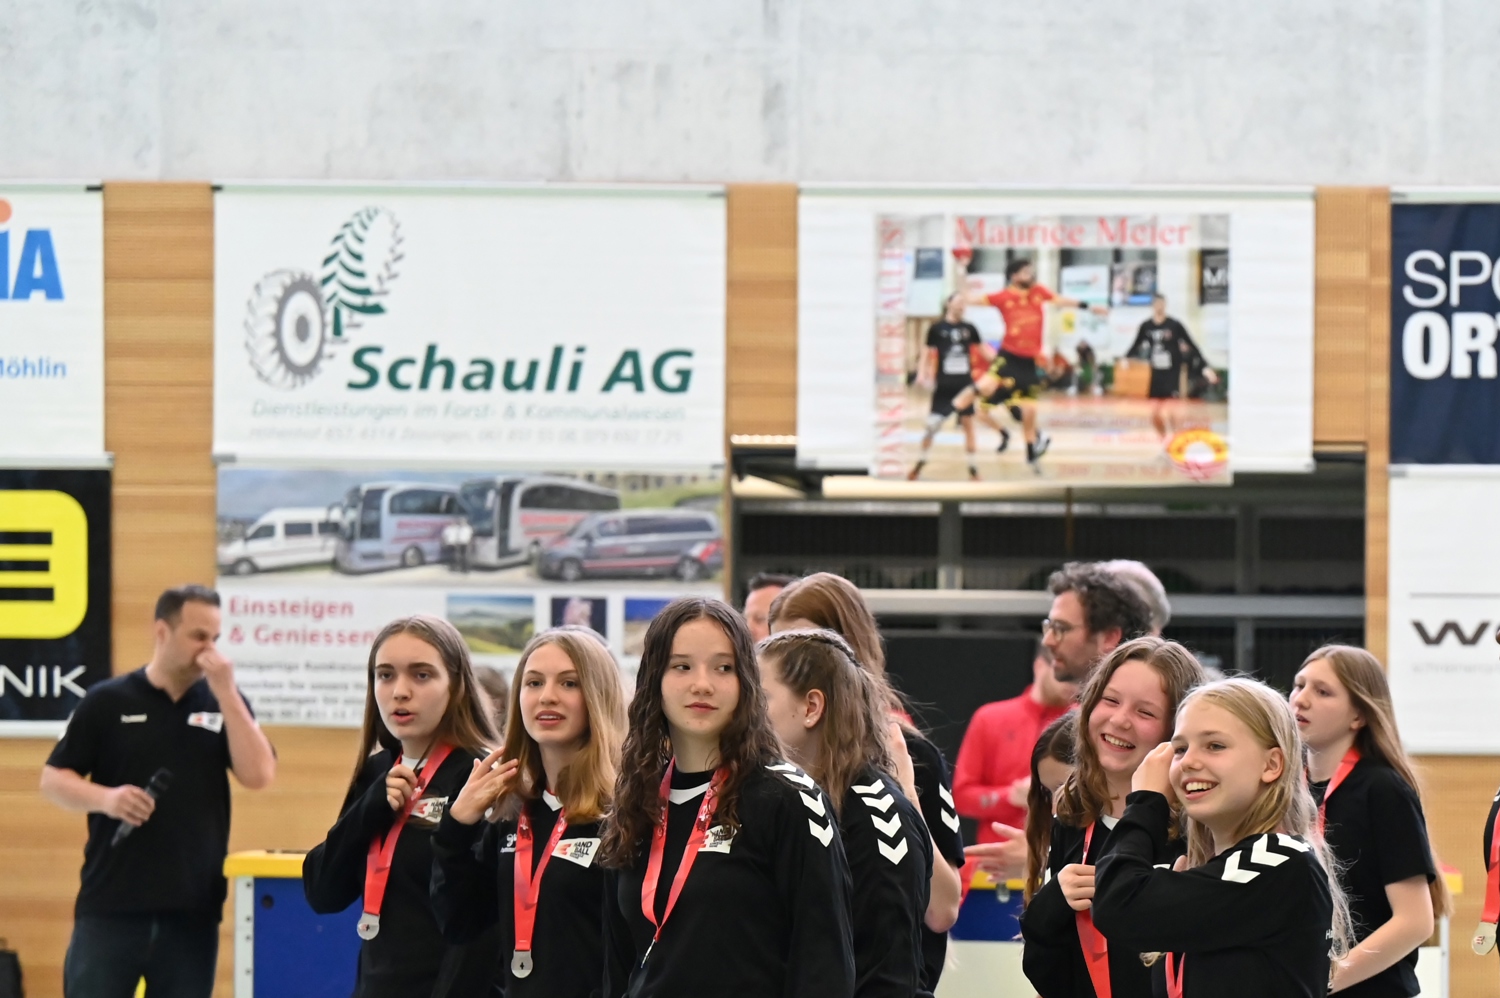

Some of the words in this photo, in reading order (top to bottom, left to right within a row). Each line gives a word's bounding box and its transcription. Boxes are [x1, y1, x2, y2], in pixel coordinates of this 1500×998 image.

[956, 216, 1085, 246] Maurice
[1096, 216, 1193, 246] Meier
[346, 344, 587, 392] Schauli
[600, 348, 695, 393] AG
[251, 400, 408, 422] Dienstleistungen
[229, 596, 354, 622] Einsteigen
[229, 625, 245, 644] &
